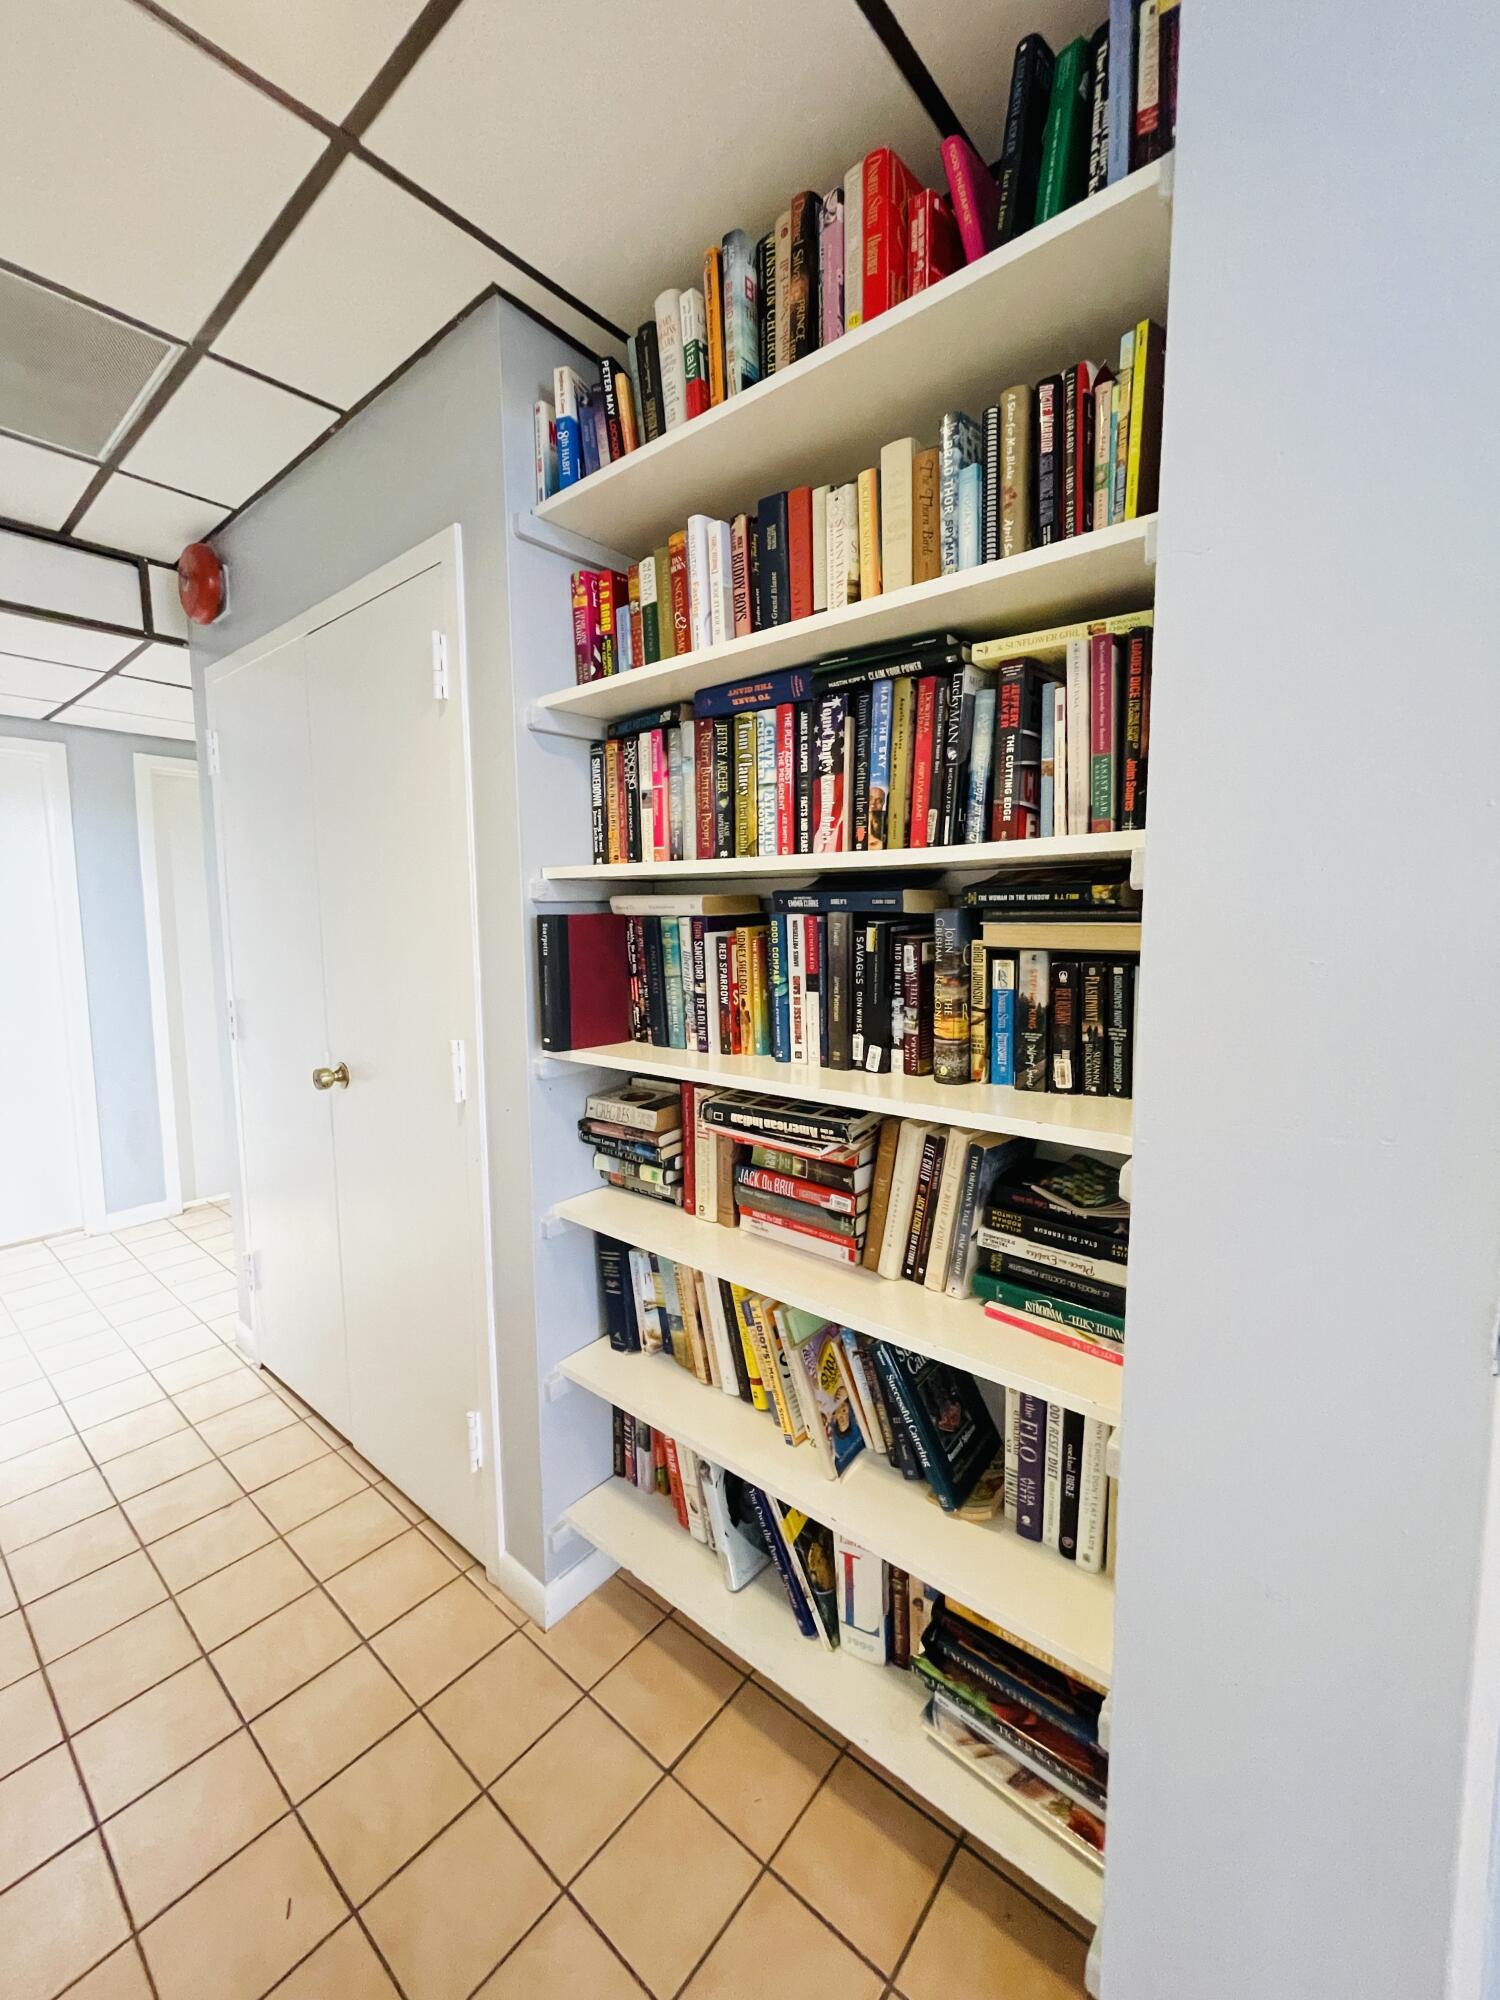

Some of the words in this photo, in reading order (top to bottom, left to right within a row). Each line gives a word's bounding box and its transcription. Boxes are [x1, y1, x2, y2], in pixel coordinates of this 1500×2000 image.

[953, 172, 973, 227] THERAPIST
[791, 199, 805, 246] Daniel
[764, 237, 778, 303] WINSTON
[791, 247, 805, 282] Silva
[794, 299, 806, 341] PRINCE
[684, 342, 697, 380] italy
[601, 359, 615, 393] PETER
[1064, 373, 1076, 403] FINAL
[606, 393, 617, 416] MAY
[1008, 393, 1016, 401] A
[1039, 383, 1055, 416] ROGUE
[1004, 401, 1017, 423] Star
[557, 430, 571, 447] 8th
[1004, 421, 1016, 437] for
[1039, 414, 1055, 455] WARRIOR
[1063, 408, 1076, 454] JEOPARDY
[562, 448, 572, 476] HABIT
[920, 460, 934, 486] The
[942, 440, 954, 477] BRAD
[1005, 455, 1015, 480] Blake
[1064, 466, 1075, 495] LINDA
[919, 486, 935, 526] Thorn
[944, 477, 955, 515] THOR
[921, 529, 935, 556] Birds
[945, 519, 956, 566] SPYMAS
[1003, 519, 1015, 542] April
[732, 551, 745, 591] BUDDY
[770, 571, 779, 595] Blanc
[673, 576, 685, 614] ANGELS
[735, 592, 748, 623] BOYS
[770, 595, 779, 620] Grand
[674, 612, 688, 630] &
[1129, 639, 1143, 674] LOADED
[880, 684, 889, 712] HALF
[1128, 675, 1142, 698] DICE
[819, 698, 838, 731] Tom
[857, 693, 871, 728] Danny
[1000, 683, 1012, 729] DEAVER
[1008, 682, 1021, 729] JEFFERY
[737, 720, 753, 750] Tom
[784, 711, 793, 730] THE
[799, 711, 808, 736] JAMES
[878, 718, 888, 742] THE
[698, 731, 712, 764] RHETT
[714, 723, 728, 757] JEFFREY
[765, 725, 776, 769] CLIVE
[784, 729, 793, 750] PLOT
[818, 730, 838, 775] Clancy
[856, 728, 870, 758] Meyer
[1006, 734, 1015, 753] THE
[627, 741, 638, 790] DANCING
[777, 751, 786, 771] THE
[784, 751, 793, 785] AGAINST
[799, 743, 808, 773] CLAPPER
[877, 744, 888, 769] SKY
[1126, 758, 1138, 780] John
[592, 758, 603, 807] SHAKEDOWN
[699, 766, 713, 811] BUTLER'S
[715, 759, 728, 795] ARCHER
[736, 753, 753, 797] Clancy
[947, 767, 955, 794] MICHAEL
[1004, 754, 1014, 795] CUTTING
[1100, 757, 1109, 791] VASANT
[777, 772, 786, 811] PRESIDENT
[799, 796, 808, 816] FACTS
[1099, 795, 1108, 816] LAD,
[1124, 780, 1138, 812] Soares
[765, 791, 776, 853] ATLANTIS
[1003, 796, 1012, 822] EDGE
[699, 812, 712, 850] PEOPLE
[799, 817, 808, 832] AND
[800, 832, 809, 853] FEARS
[978, 893, 987, 902] THE
[987, 893, 1008, 902] WOMAN
[1008, 893, 1015, 901] IN
[1015, 893, 1026, 901] THE
[1026, 893, 1050, 901] WINDOW
[541, 922, 549, 956] Scarpetta
[693, 921, 702, 940] JOHN
[736, 930, 747, 959] SIDNEY
[770, 920, 779, 944] GOOD
[792, 919, 800, 950] PATTERSON
[934, 917, 946, 962] GRISHAM
[944, 927, 956, 953] JOHN
[693, 940, 704, 980] SANDFORD
[718, 942, 728, 960] RED
[771, 945, 781, 985] COMPANY
[792, 950, 800, 968] JAMES
[854, 936, 865, 985] SAVAGES
[893, 943, 902, 960] INTO
[972, 945, 985, 964] BIRD
[719, 962, 729, 1006] SPARROW
[738, 959, 749, 997] SHELDON
[833, 975, 842, 994] James
[893, 962, 902, 981] THIN
[893, 981, 902, 996] AIR
[972, 970, 984, 1006] JOHNSON
[1084, 975, 1101, 1022] FLASHPOINT
[1113, 974, 1123, 1009] SANDFORD
[696, 997, 708, 1042] DEADLINE
[833, 994, 842, 1022] Patterson
[943, 997, 954, 1016] THE
[1028, 1007, 1037, 1030] KING
[1113, 1010, 1123, 1028] JOHN
[1084, 1043, 1094, 1092] BROCKMANN
[1092, 1050, 1102, 1085] SUZANNE
[1113, 1056, 1123, 1083] CHOSEN
[730, 1111, 764, 1129] Indian
[763, 1118, 819, 1139] American
[924, 1143, 935, 1158] LEE
[969, 1155, 980, 1171] THE
[737, 1168, 760, 1189] JACK
[760, 1172, 774, 1189] Du
[773, 1176, 797, 1199] BRUL
[920, 1157, 933, 1182] CHILD
[914, 1194, 926, 1210] JACK
[964, 1171, 977, 1208] ORPHAN'S
[911, 1209, 924, 1235] REACHER
[961, 1209, 973, 1227] TALE
[957, 1232, 968, 1249] PAM
[1033, 1226, 1067, 1243] TERREUR
[1067, 1234, 1080, 1245] DE
[953, 1249, 966, 1276] JENOFF
[755, 1320, 771, 1361] IDIOT'S
[766, 1366, 782, 1407] Managing
[777, 1407, 788, 1434] Stress
[1023, 1402, 1035, 1419] the
[885, 1373, 916, 1424] Successful
[907, 1424, 933, 1469] Catering
[1018, 1418, 1038, 1464] FLO
[1046, 1426, 1059, 1457] RESET
[1046, 1456, 1059, 1482] DIET
[1065, 1442, 1077, 1474] cocktail
[1091, 1441, 1103, 1475] CHICKS
[748, 1486, 759, 1505] You
[1018, 1476, 1028, 1504] VITTI
[1026, 1477, 1036, 1507] ALISA
[1064, 1473, 1076, 1500] BIBLE
[1090, 1474, 1101, 1501] DON'T
[753, 1506, 767, 1529] Own
[1089, 1501, 1100, 1518] EAT
[761, 1529, 773, 1544] the
[1086, 1519, 1098, 1552] SALADS
[767, 1544, 783, 1573] Power
